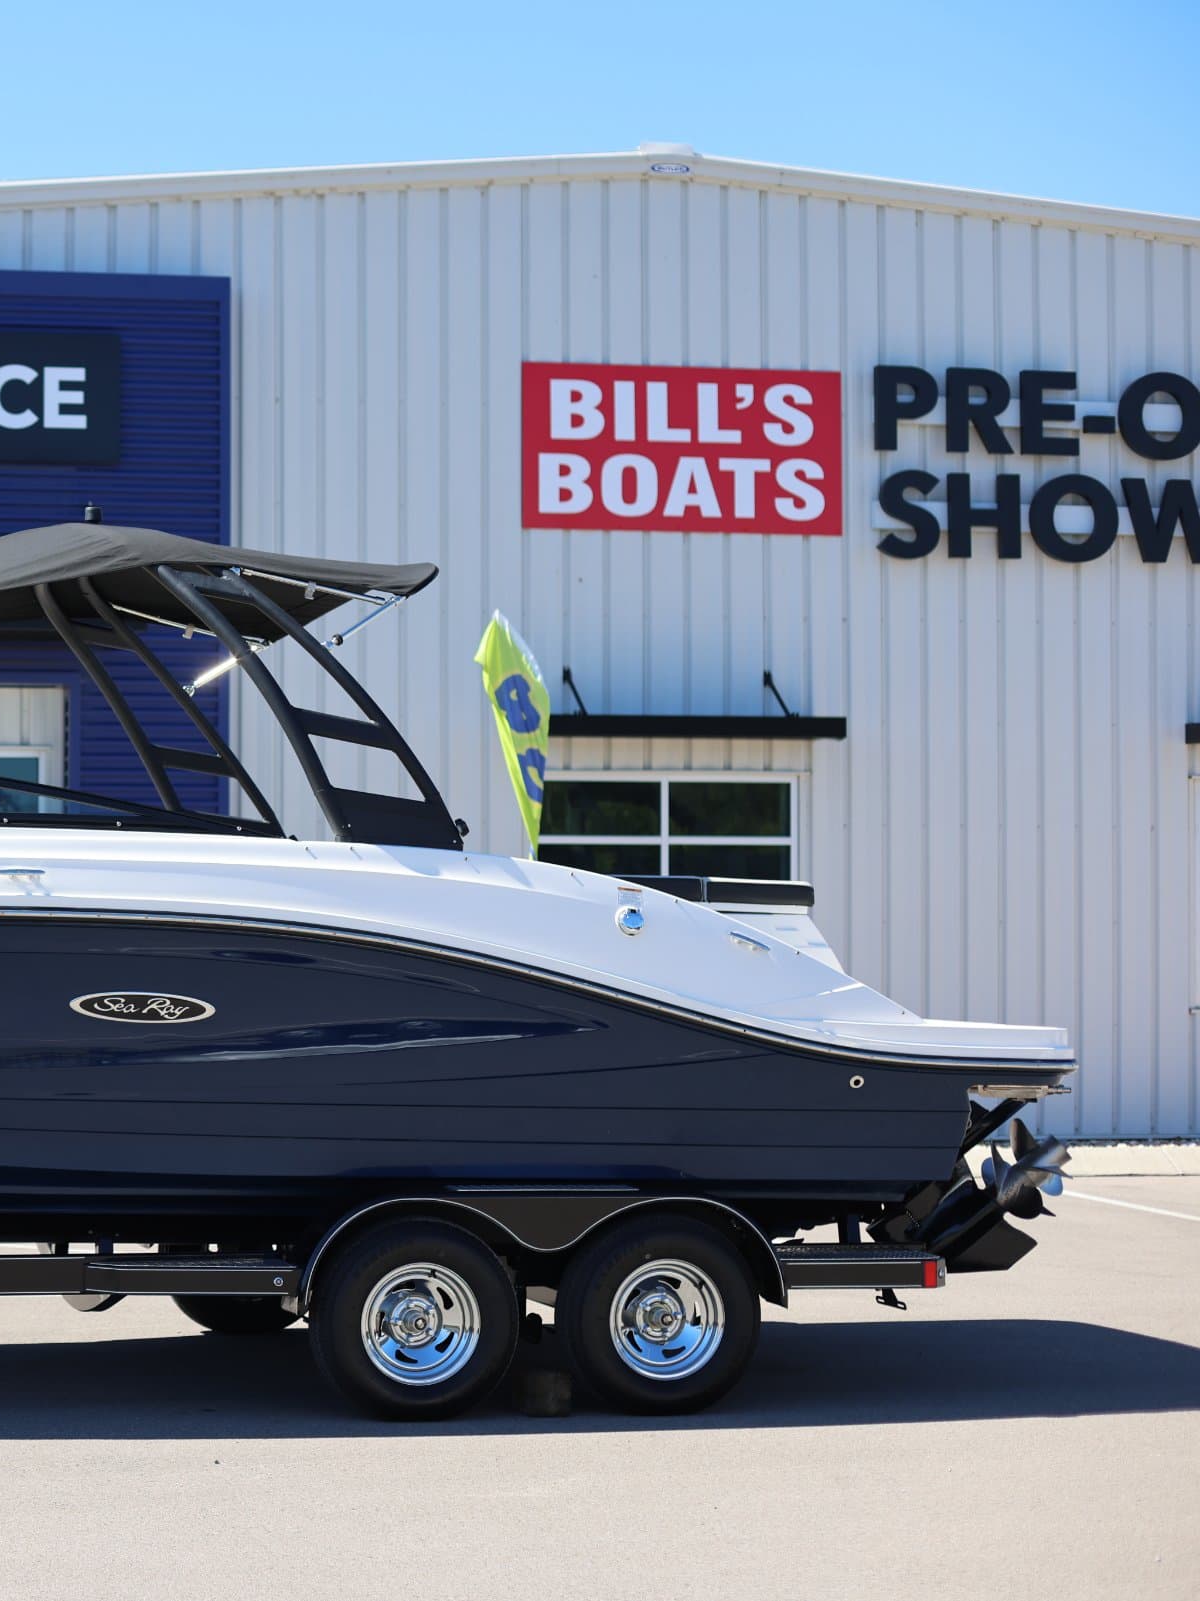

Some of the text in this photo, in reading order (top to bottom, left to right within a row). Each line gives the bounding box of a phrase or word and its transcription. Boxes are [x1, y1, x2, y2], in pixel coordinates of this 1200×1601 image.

[549, 378, 815, 447] BILL'S
[873, 364, 1200, 460] PRE-O
[538, 452, 826, 521] BOATS
[876, 469, 1200, 563] SHOW
[94, 997, 190, 1019] Sea Ray
